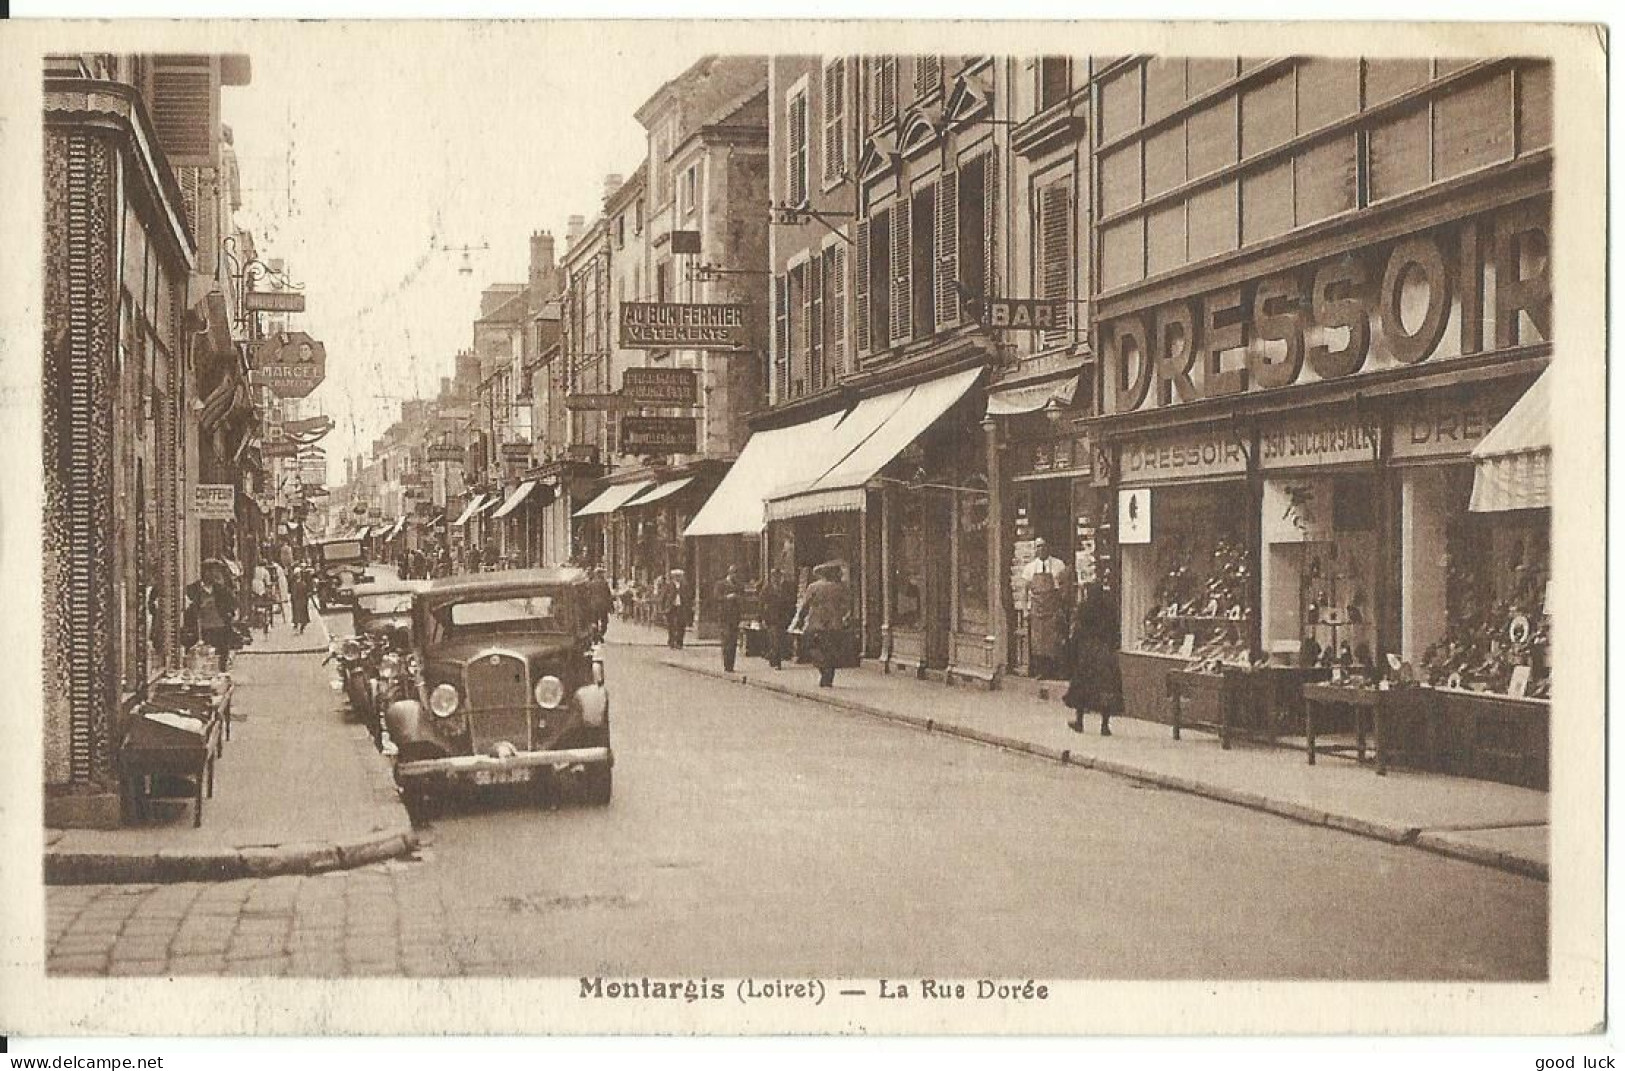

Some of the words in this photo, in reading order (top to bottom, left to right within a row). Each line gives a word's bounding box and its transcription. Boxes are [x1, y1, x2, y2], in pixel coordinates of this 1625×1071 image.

[625, 306, 645, 326] AU
[648, 305, 676, 326] BON
[680, 305, 743, 327] FERMIER
[991, 303, 1053, 327] BAR
[1113, 215, 1552, 412] DRESSOIR
[262, 366, 321, 378] MARCEL
[1129, 440, 1240, 472] DRESSOIR
